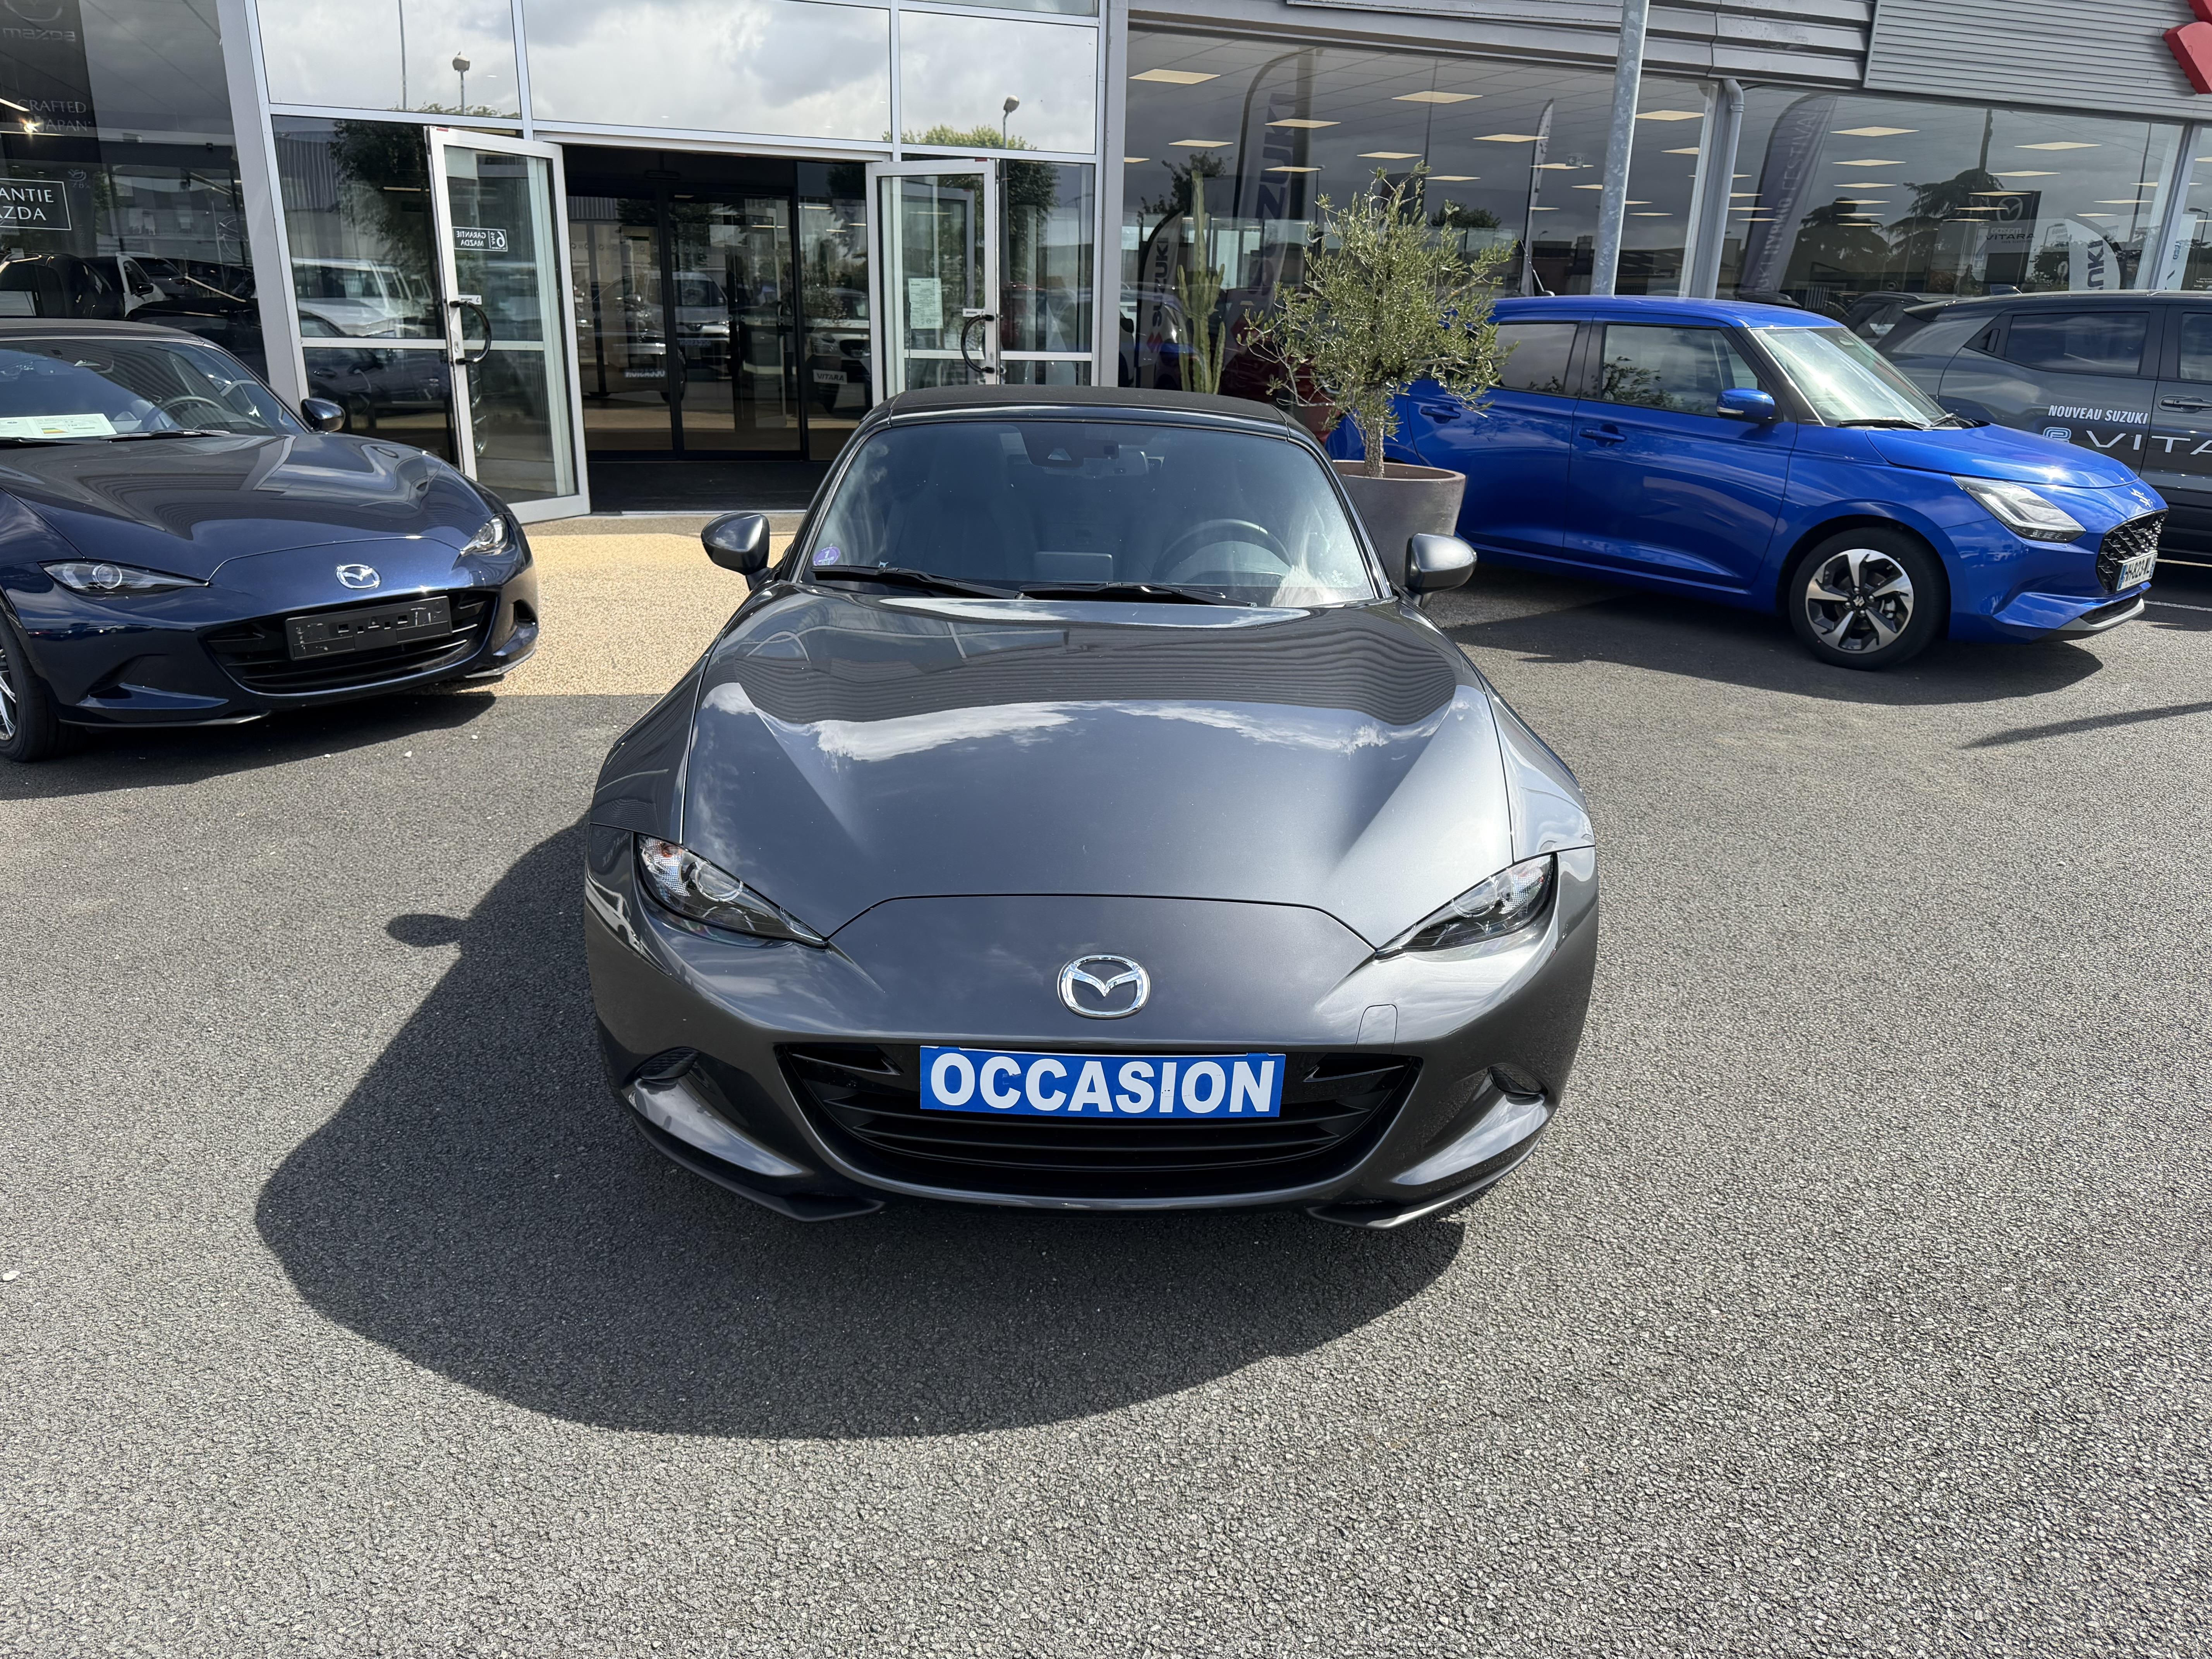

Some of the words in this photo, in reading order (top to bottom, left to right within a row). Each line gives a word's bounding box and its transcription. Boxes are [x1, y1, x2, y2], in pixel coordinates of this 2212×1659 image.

[43, 118, 88, 132] APAN
[0, 206, 46, 221] ZDA
[817, 373, 844, 381] VITARA
[2048, 405, 2102, 421] NOUVEAU
[2104, 409, 2149, 424] SUZUKI
[930, 1053, 1275, 1114] OCCASION
